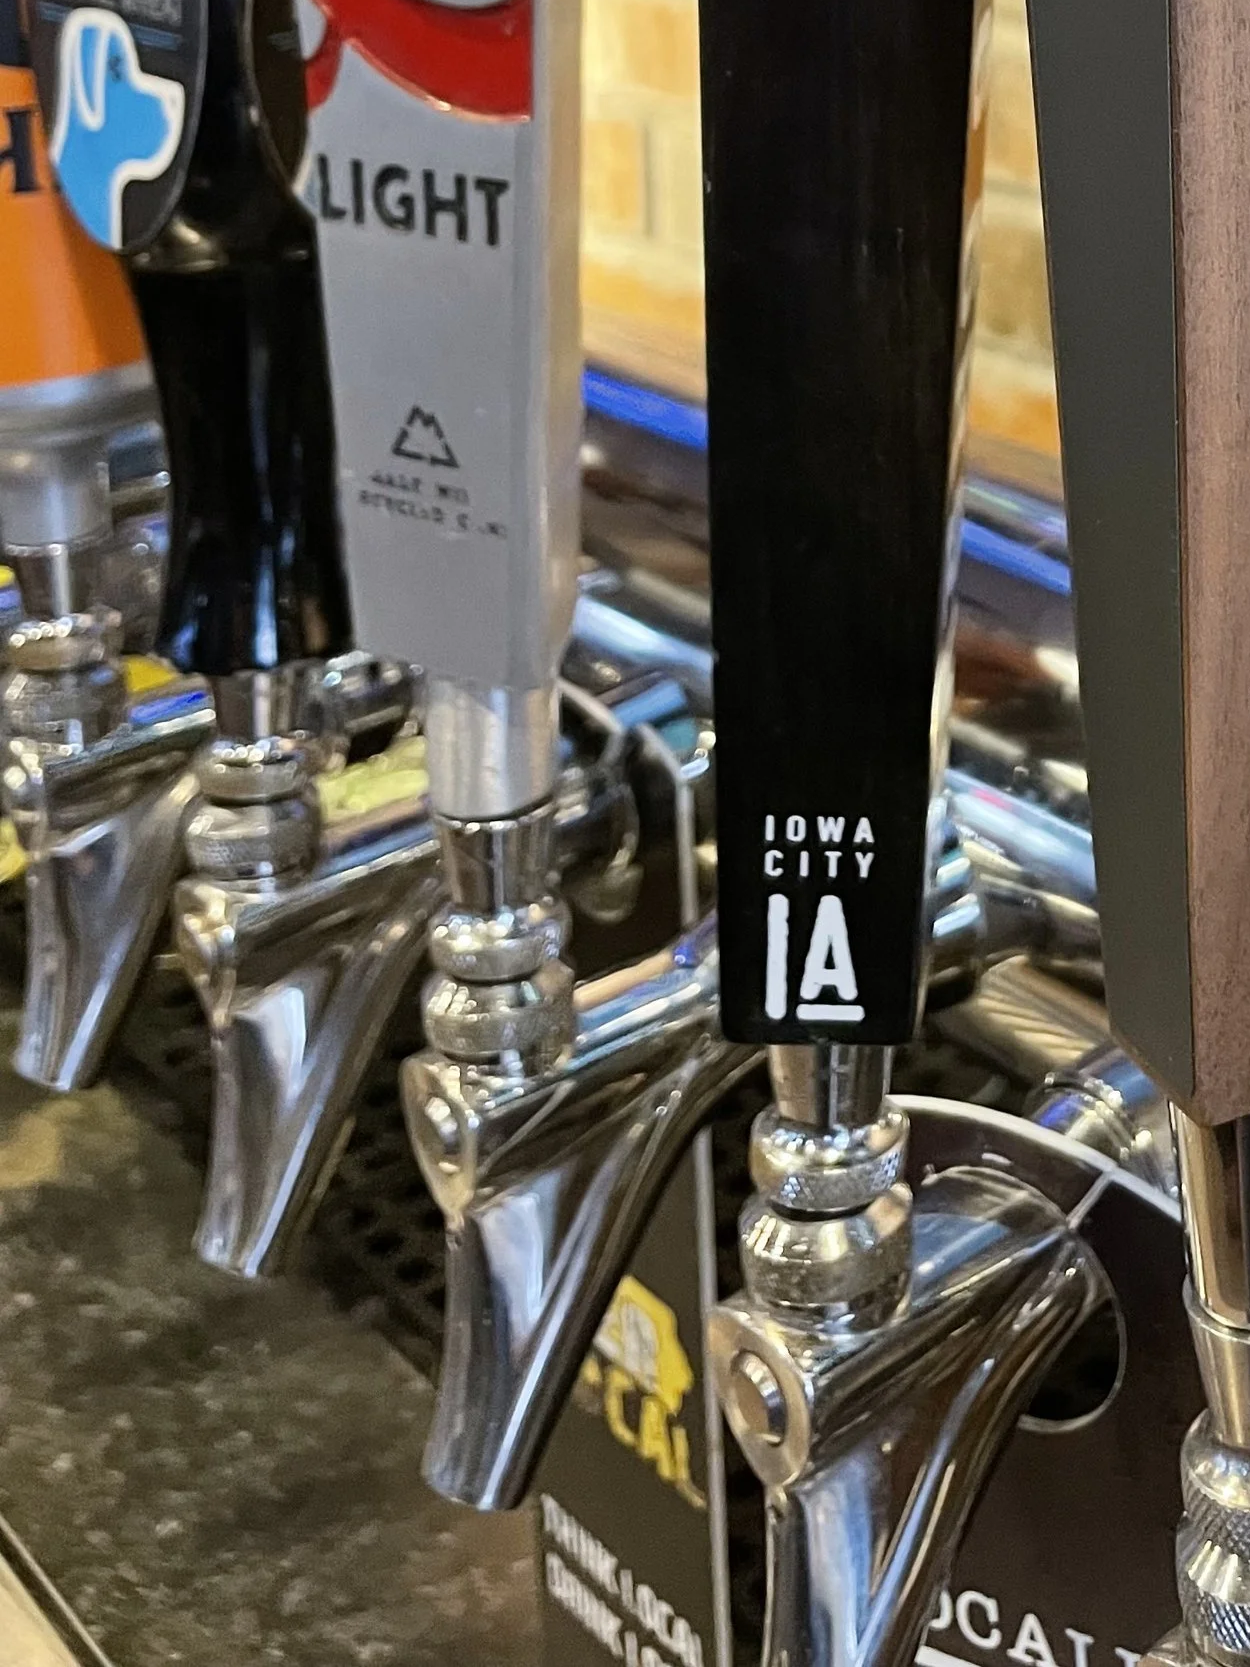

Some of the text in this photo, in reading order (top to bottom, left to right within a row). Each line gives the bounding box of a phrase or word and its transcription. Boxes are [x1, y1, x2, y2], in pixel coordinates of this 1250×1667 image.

[316, 151, 510, 247] LIGHT
[764, 814, 875, 844] IOWA
[763, 849, 875, 878] CITY
[764, 893, 866, 1022] IA
